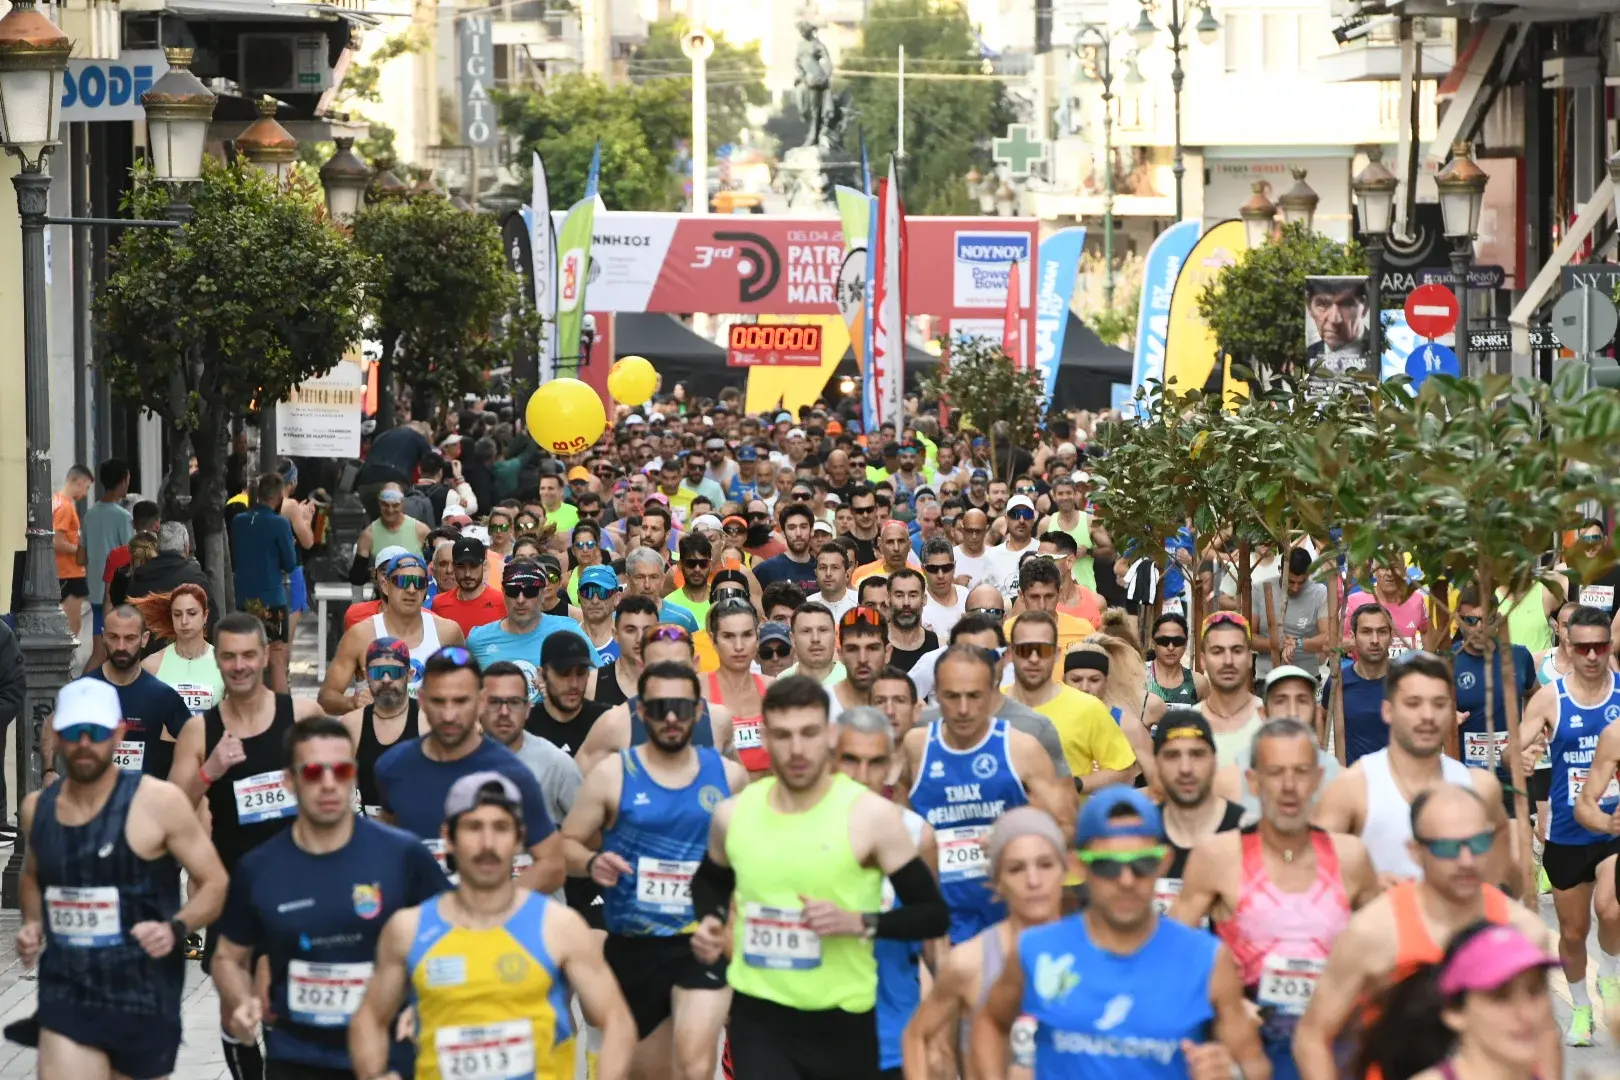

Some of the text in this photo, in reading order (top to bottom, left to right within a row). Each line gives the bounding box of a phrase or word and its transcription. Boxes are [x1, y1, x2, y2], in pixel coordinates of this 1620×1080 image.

[465, 14, 490, 143] MIGATO
[690, 245, 735, 269] 3rd
[1572, 272, 1601, 289] NY
[1583, 594, 1606, 603] 2020
[1470, 745, 1502, 756] 225
[244, 788, 286, 808] 2386
[944, 783, 982, 803] ΣΜΑΧ
[645, 880, 692, 898] 2172
[53, 910, 99, 928] 2038
[750, 926, 800, 949] 2018
[297, 987, 350, 1006] 2027
[1052, 1028, 1179, 1066] saucony
[451, 1051, 510, 1077] 2013
